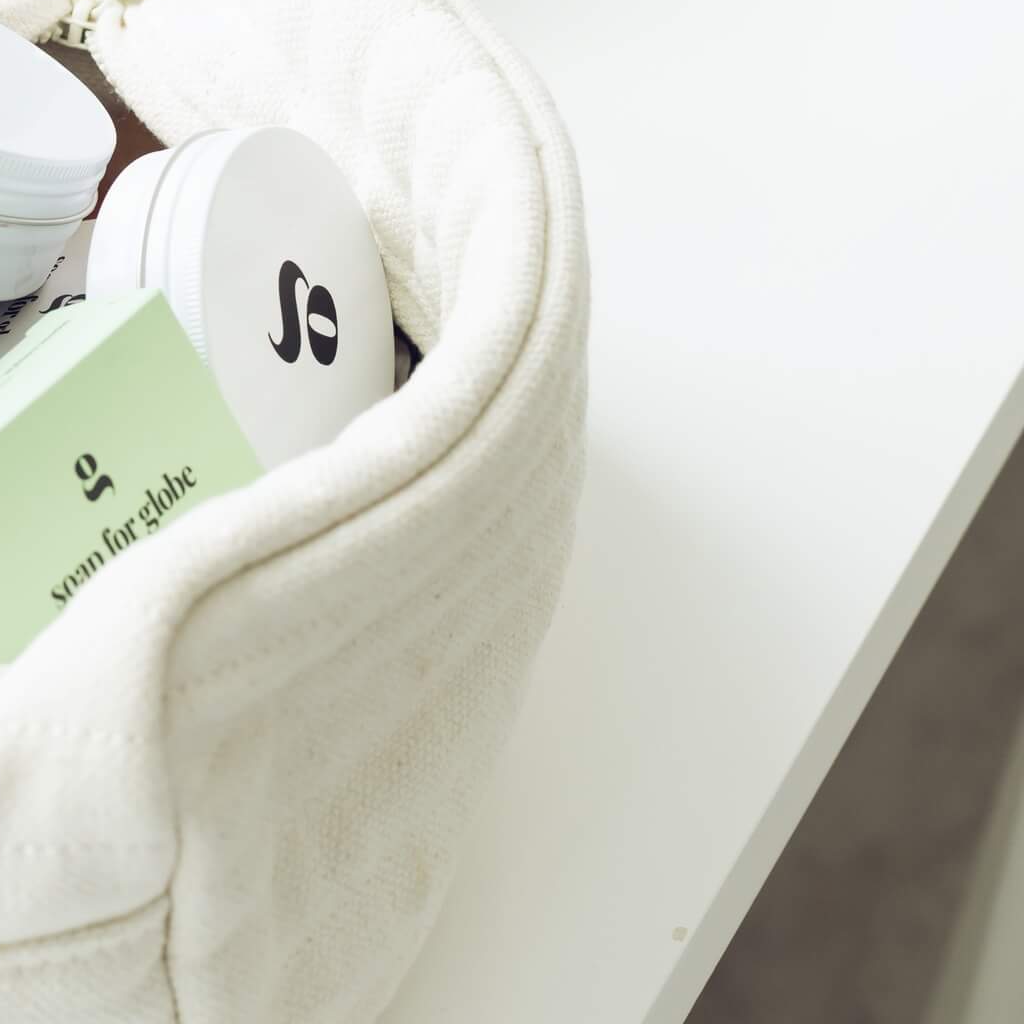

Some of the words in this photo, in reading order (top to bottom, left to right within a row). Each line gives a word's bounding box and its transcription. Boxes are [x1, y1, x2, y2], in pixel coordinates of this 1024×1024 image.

[74, 453, 116, 502] g
[102, 517, 138, 556] for
[138, 465, 197, 535] globe
